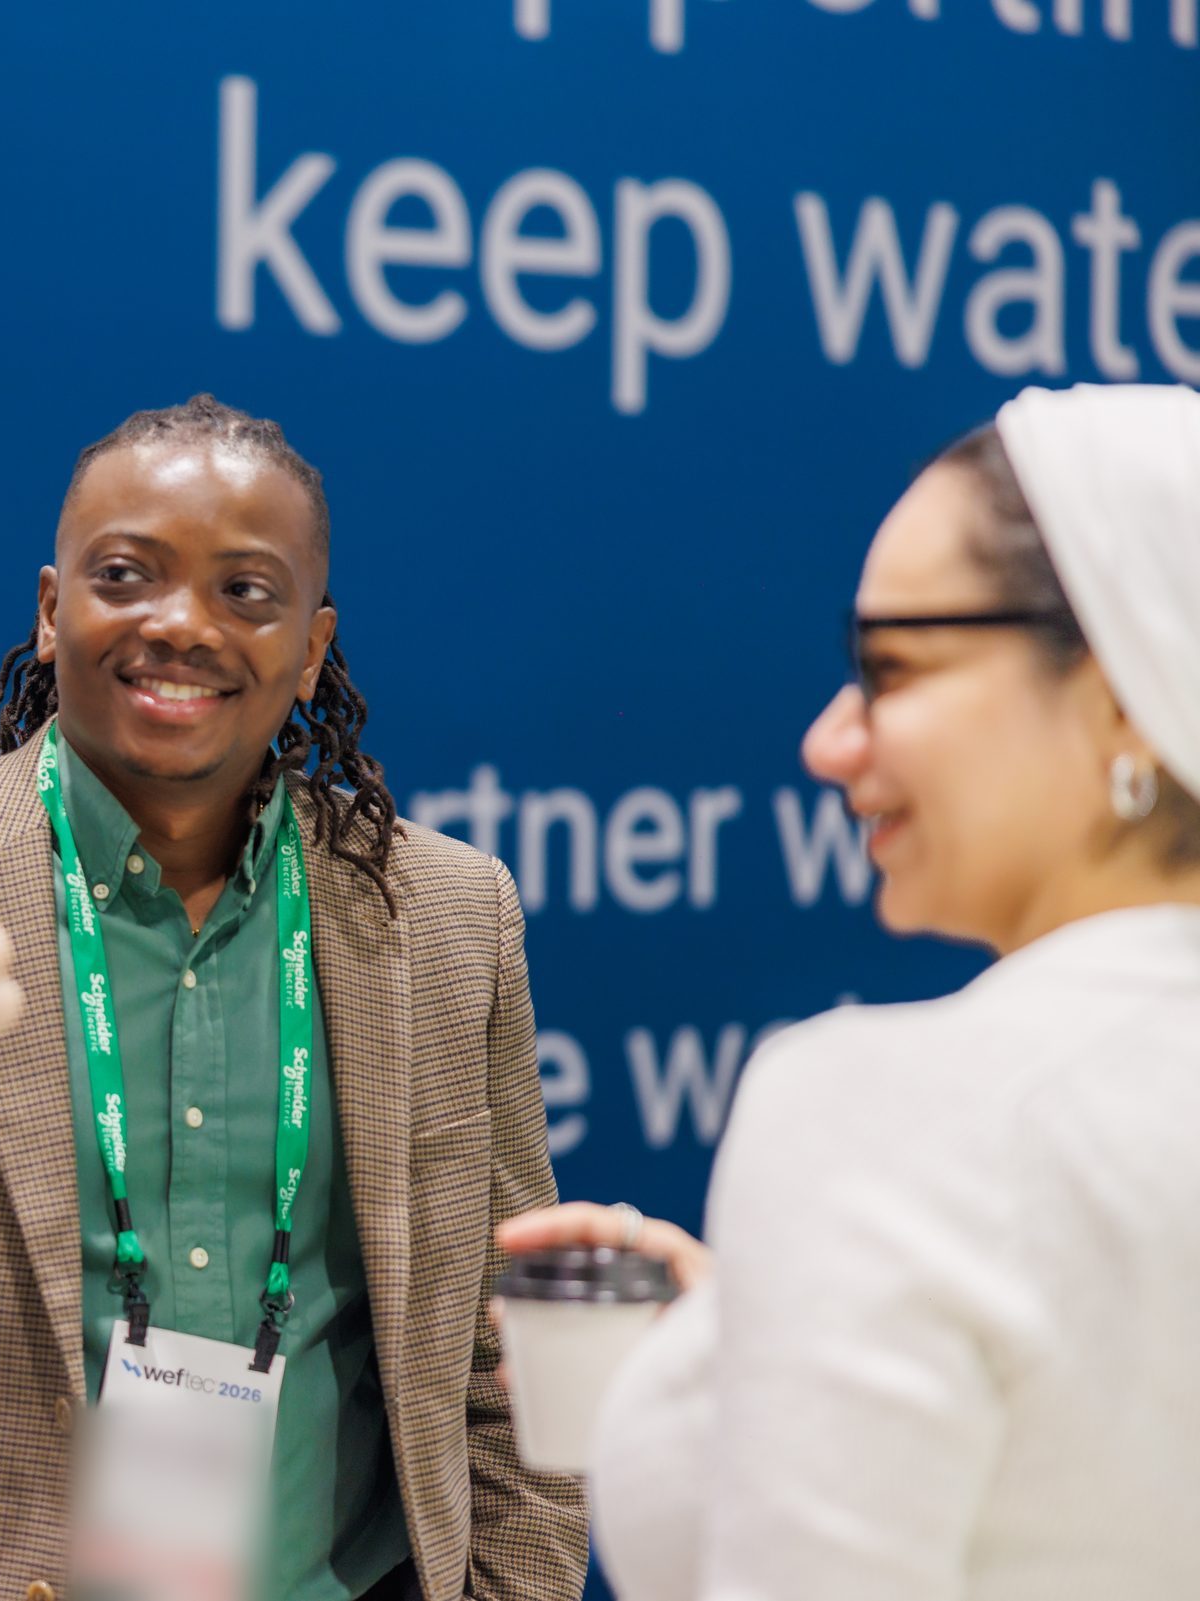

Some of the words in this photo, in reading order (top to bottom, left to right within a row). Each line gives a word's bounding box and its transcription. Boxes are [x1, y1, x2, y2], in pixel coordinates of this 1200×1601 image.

[217, 74, 732, 416] keep
[283, 930, 308, 1010] Schneider
[81, 972, 113, 1055] Schneider
[283, 1046, 308, 1129] Schneider
[143, 1365, 215, 1395] weftec
[218, 1381, 263, 1403] 2026
